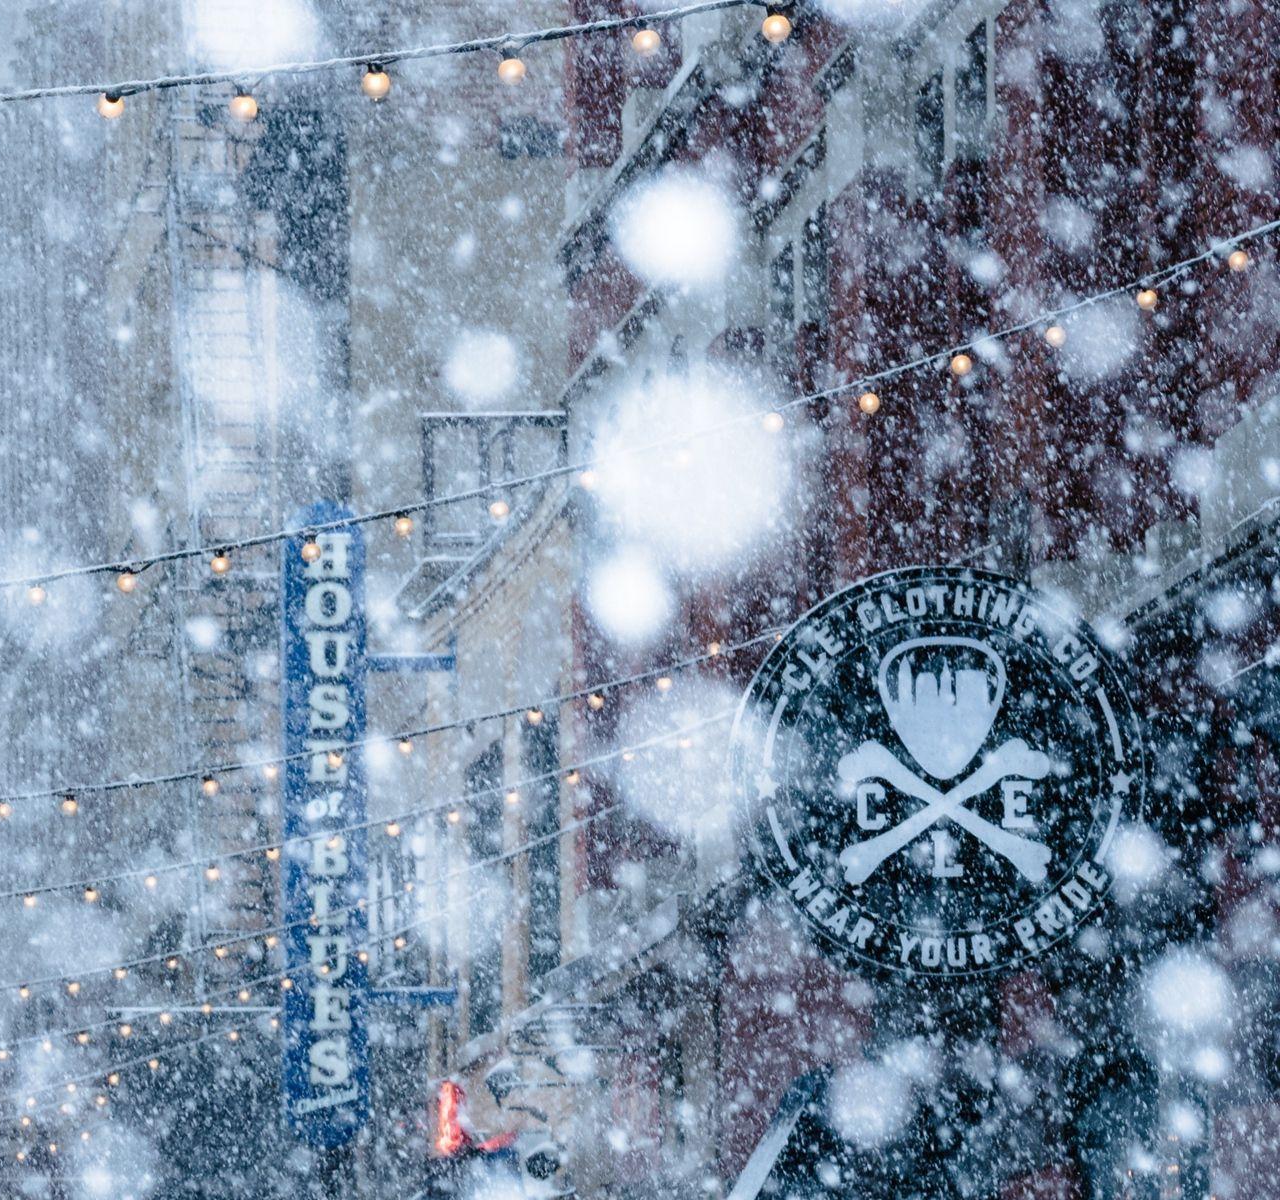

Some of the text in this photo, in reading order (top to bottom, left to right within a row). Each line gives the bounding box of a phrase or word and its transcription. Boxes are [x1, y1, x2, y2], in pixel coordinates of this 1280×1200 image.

[304, 532, 352, 783] HOUSE
[781, 586, 1097, 693] CLE CLOTHING CO.
[306, 791, 343, 821] of
[305, 835, 352, 1086] BLUES
[787, 863, 1109, 968] WEAR YOUR PRIDE
